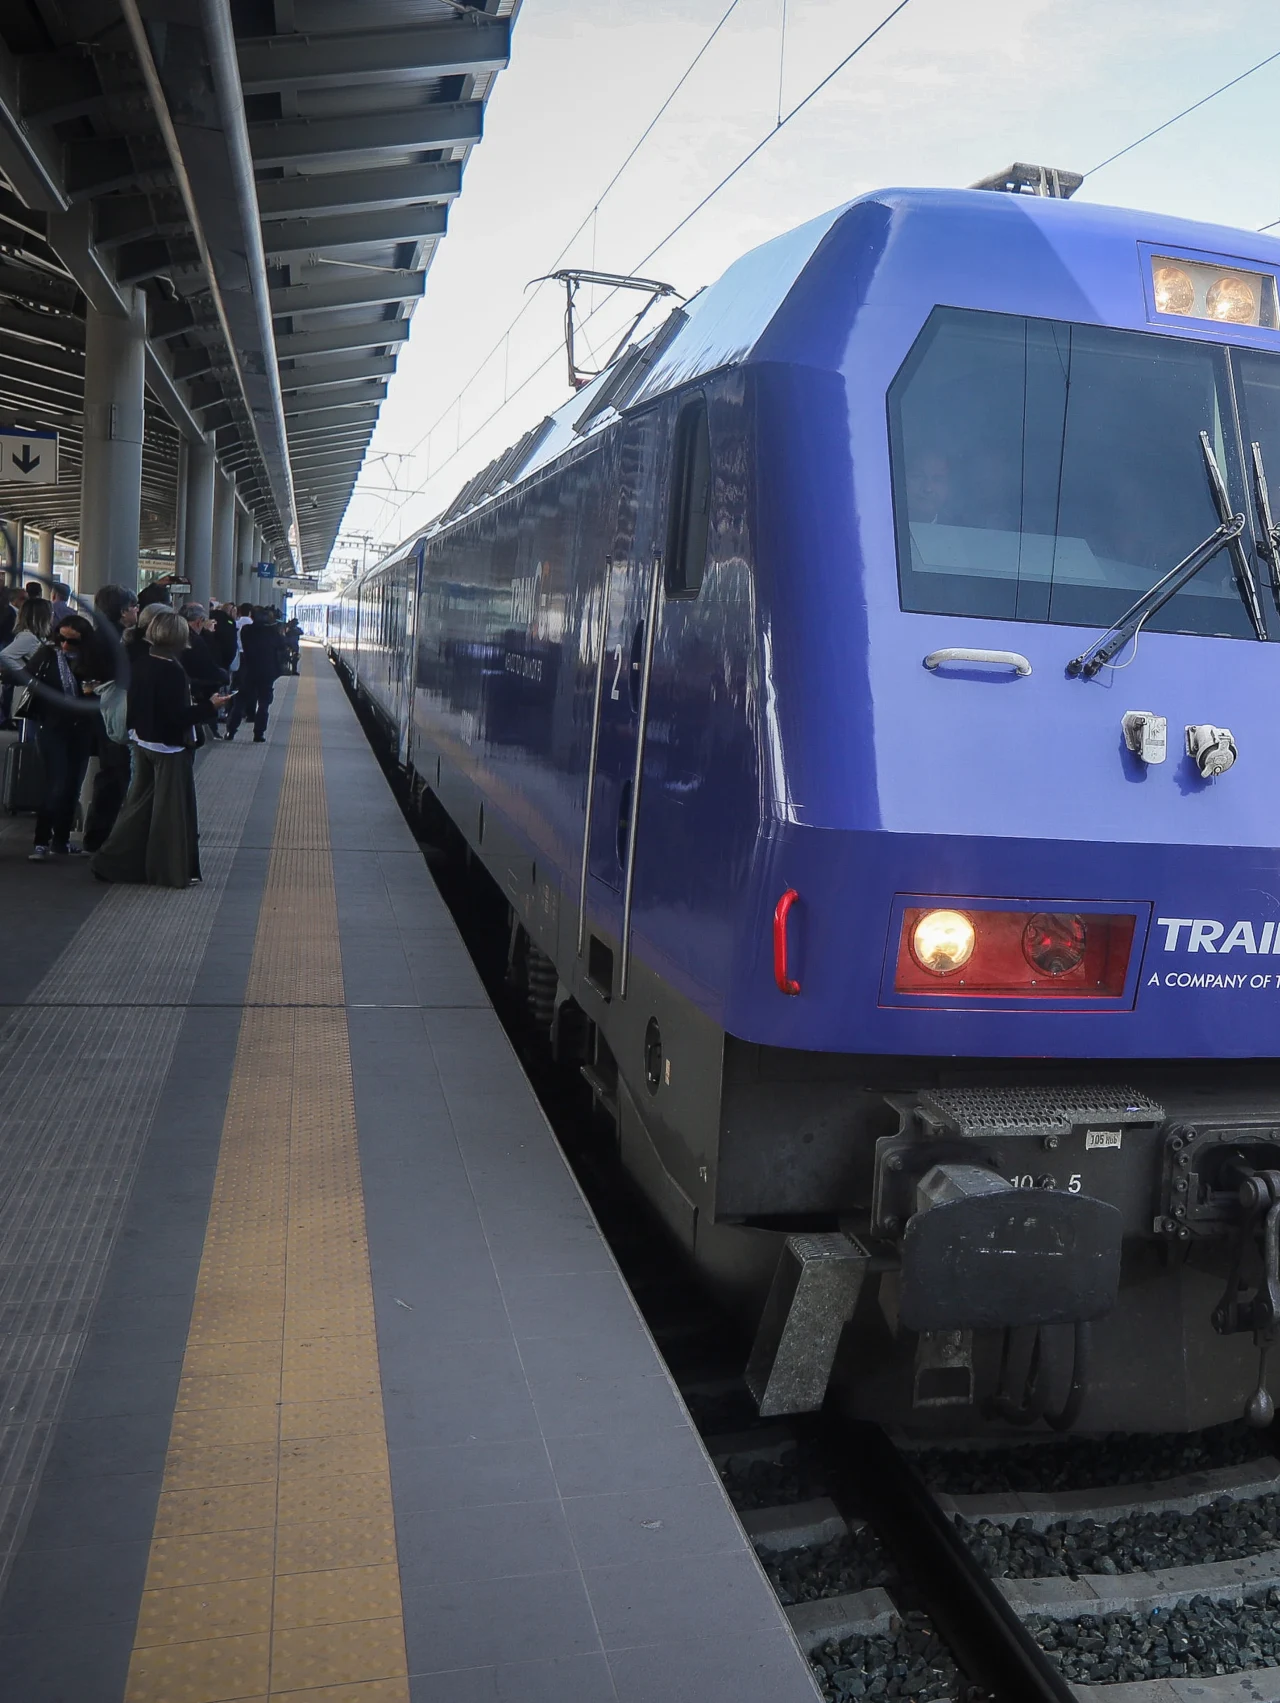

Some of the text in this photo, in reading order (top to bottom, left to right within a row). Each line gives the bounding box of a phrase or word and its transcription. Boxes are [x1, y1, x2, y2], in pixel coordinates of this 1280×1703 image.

[1147, 972, 1160, 986] A
[1165, 972, 1248, 988] COMPANY
[1250, 974, 1272, 988] OF
[1068, 1174, 1082, 1193] 5
